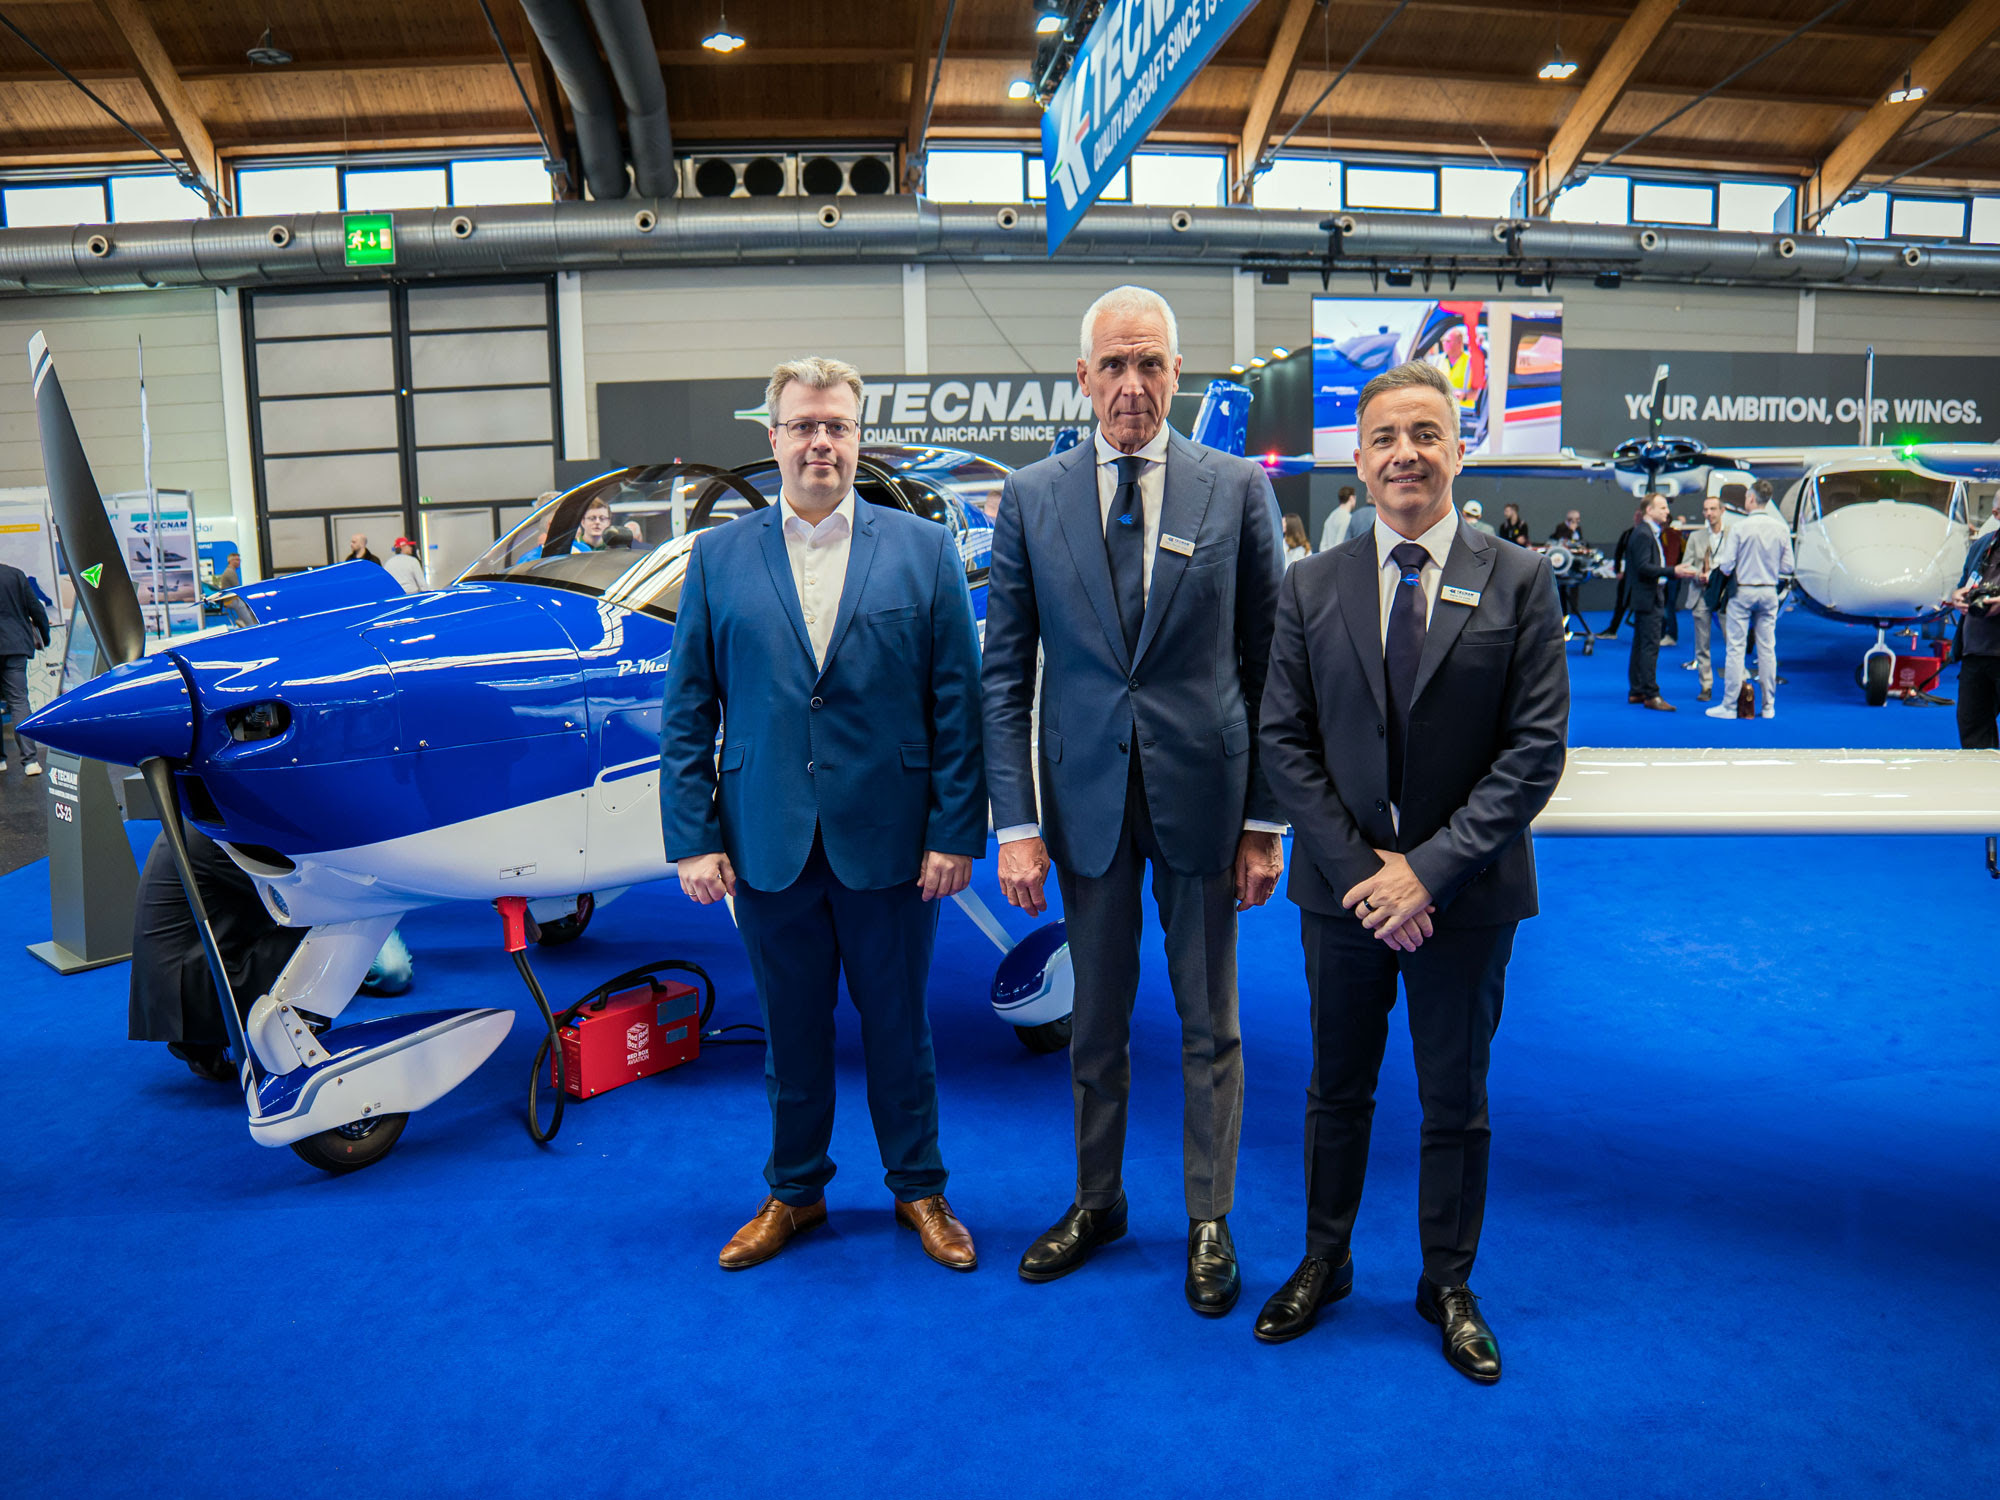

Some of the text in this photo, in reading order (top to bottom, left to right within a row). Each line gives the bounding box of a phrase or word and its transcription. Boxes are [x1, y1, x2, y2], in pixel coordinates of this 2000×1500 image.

[1090, 0, 1176, 132] TECN
[1093, 0, 1201, 172] QUALITY AIRCRAFT SINCE
[862, 381, 1093, 424] TECNAM
[1701, 395, 1833, 425] AMBITION,
[1893, 399, 1982, 424] WINGS.
[863, 427, 929, 443] QUALITY
[930, 425, 1007, 442] AIRCRAFT
[1010, 425, 1055, 441] SINCE
[55, 802, 72, 822] CS-23
[627, 1054, 650, 1066] AVIATION
